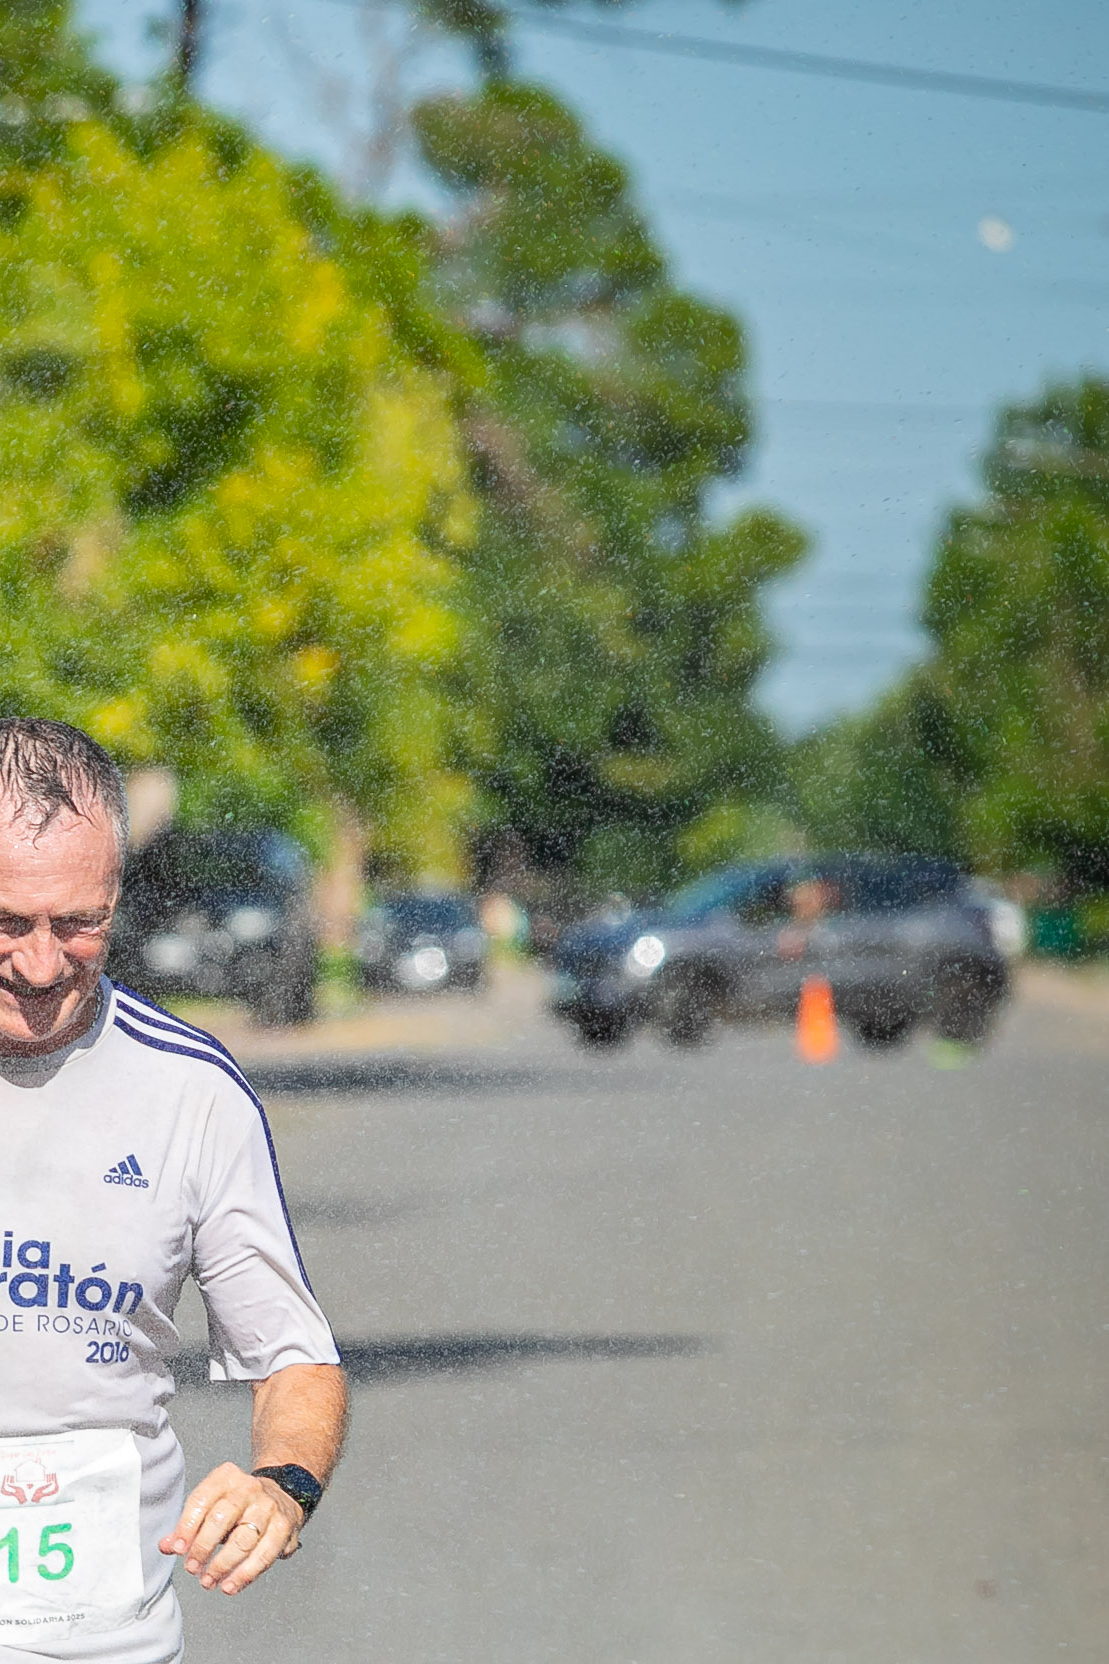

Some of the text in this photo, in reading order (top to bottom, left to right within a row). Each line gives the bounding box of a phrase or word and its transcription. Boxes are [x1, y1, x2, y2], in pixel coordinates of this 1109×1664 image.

[103, 1172, 149, 1189] adidas
[37, 1314, 133, 1337] ROSARIO
[85, 1341, 130, 1363] 2016
[14, 1615, 64, 1626] SOLIDARIA
[66, 1612, 86, 1622] 2025
